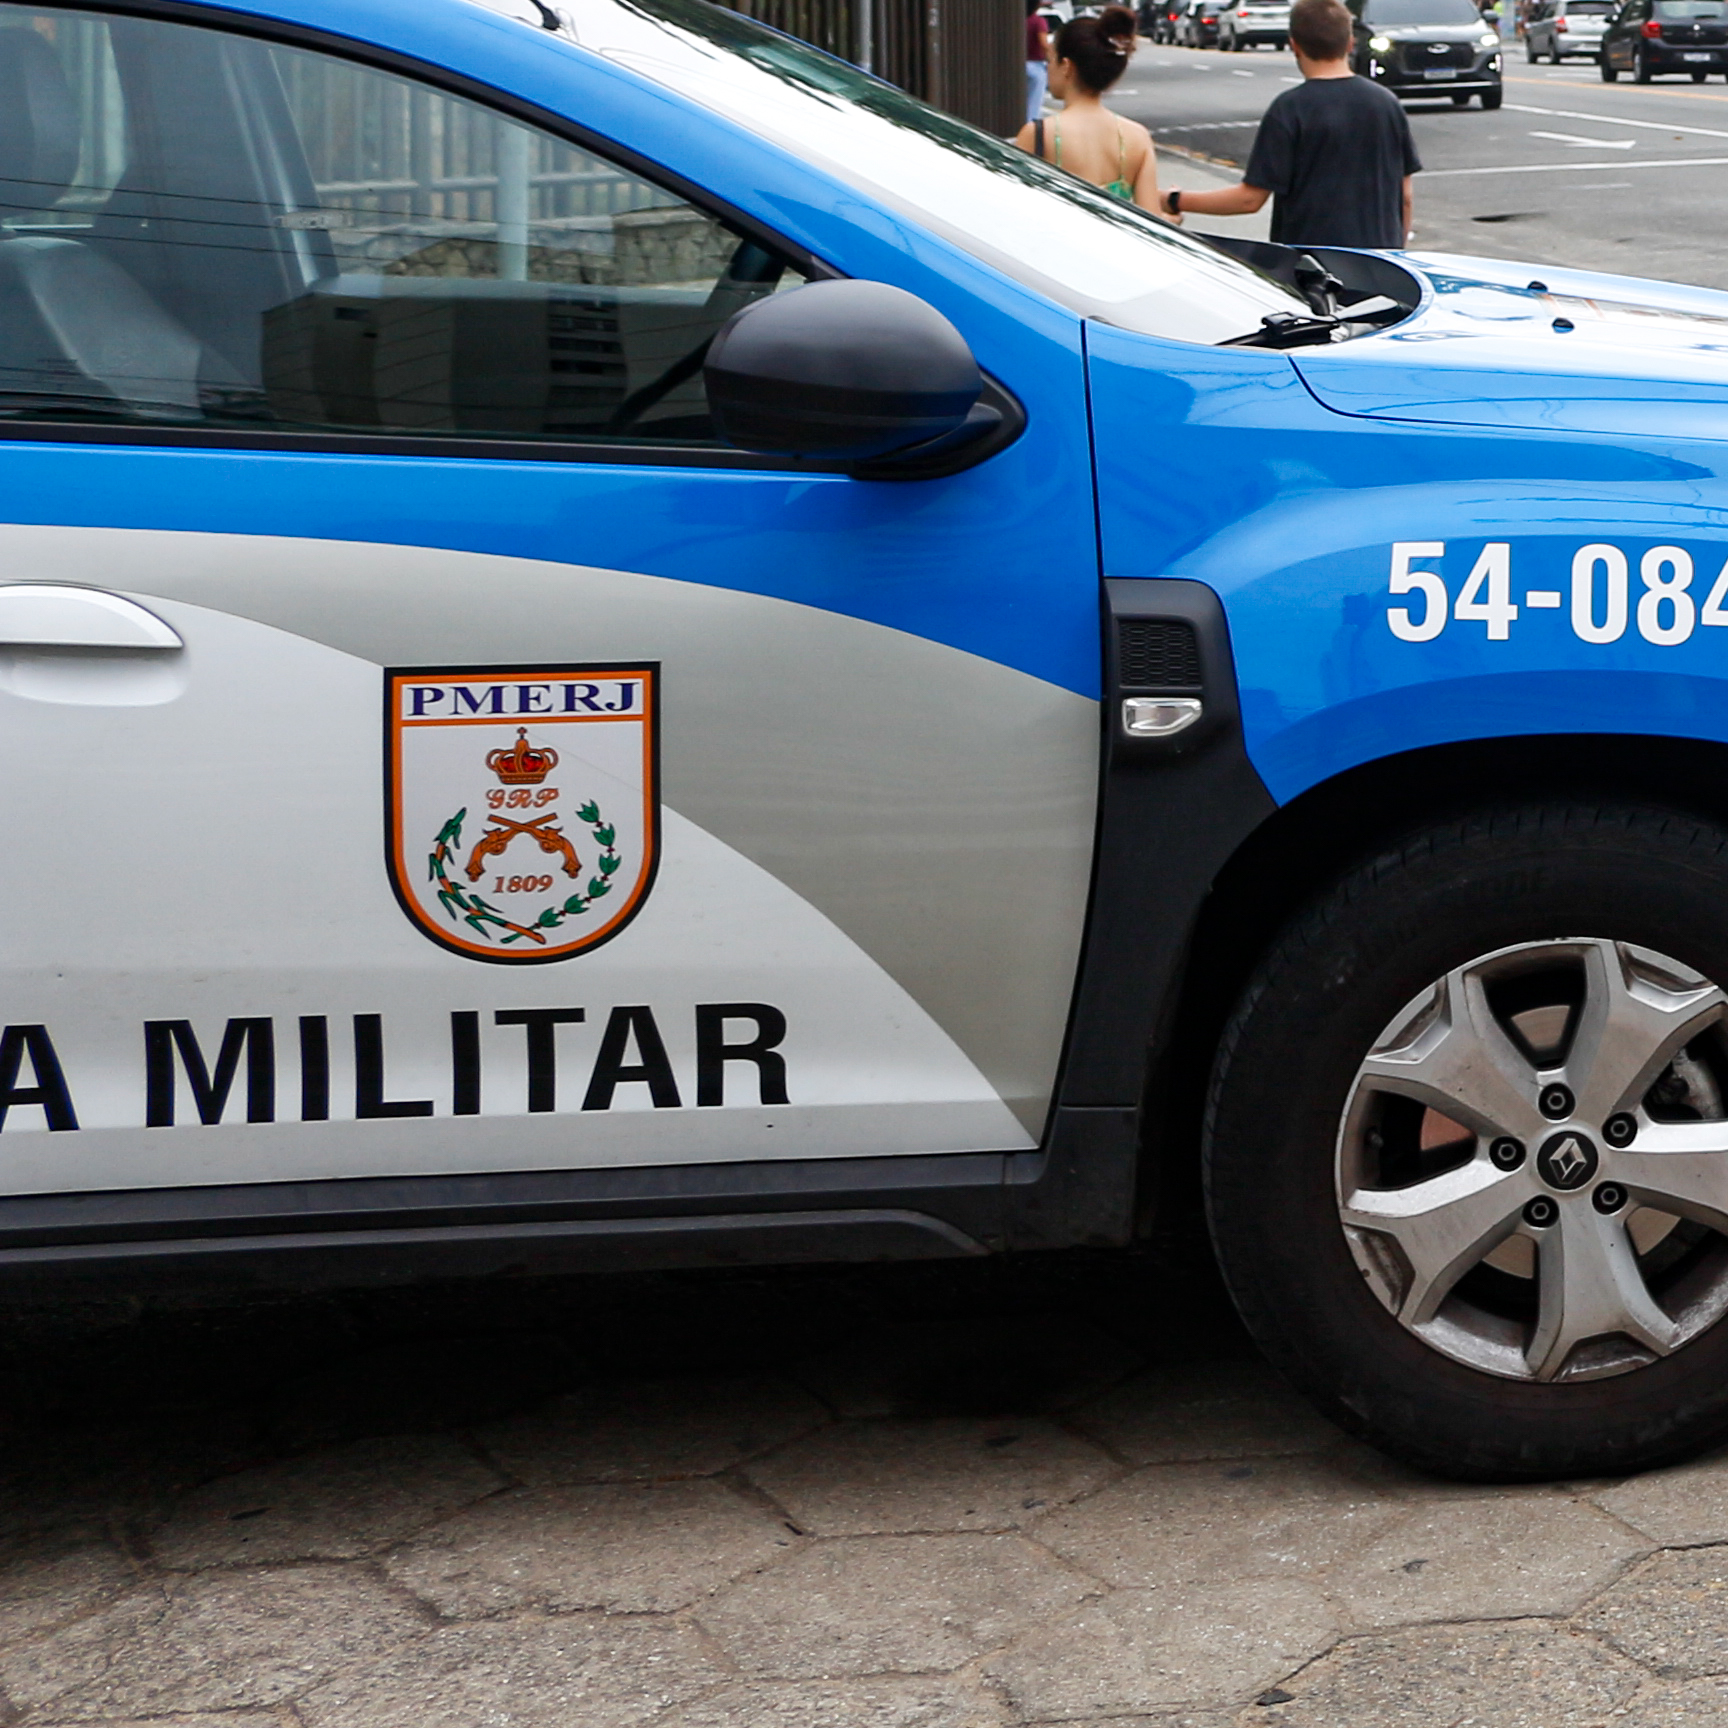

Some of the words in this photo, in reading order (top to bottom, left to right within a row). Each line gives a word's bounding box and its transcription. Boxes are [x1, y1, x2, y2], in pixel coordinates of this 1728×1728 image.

[407, 680, 640, 718] PMERJ
[492, 874, 554, 894] 1809
[0, 1024, 80, 1132] A
[144, 1002, 792, 1129] MILITAR
